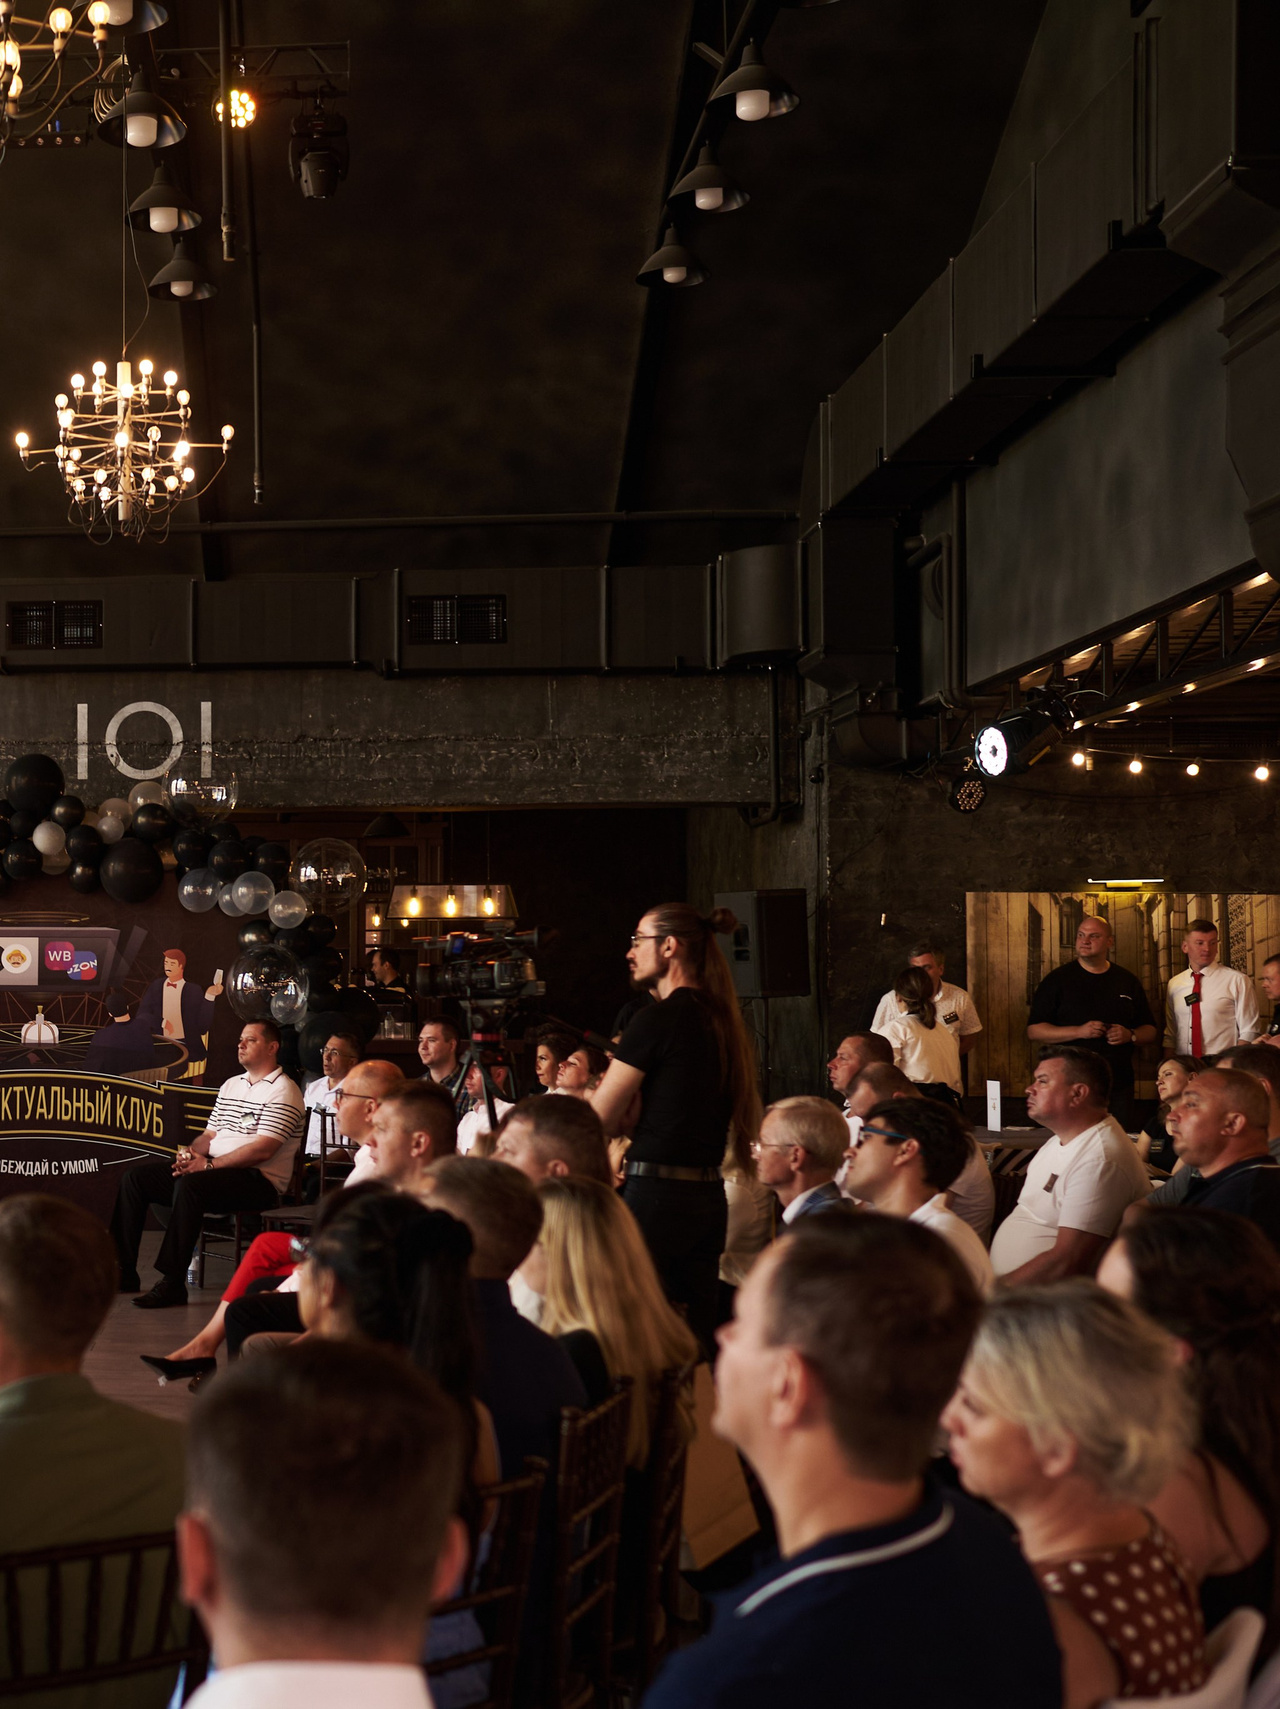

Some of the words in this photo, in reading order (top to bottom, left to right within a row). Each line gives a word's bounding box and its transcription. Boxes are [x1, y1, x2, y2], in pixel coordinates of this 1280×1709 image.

[47, 950, 72, 962] WB
[116, 1093, 164, 1139] КЛУБ
[51, 1162, 59, 1175] С
[61, 1158, 99, 1175] УМОМ!
